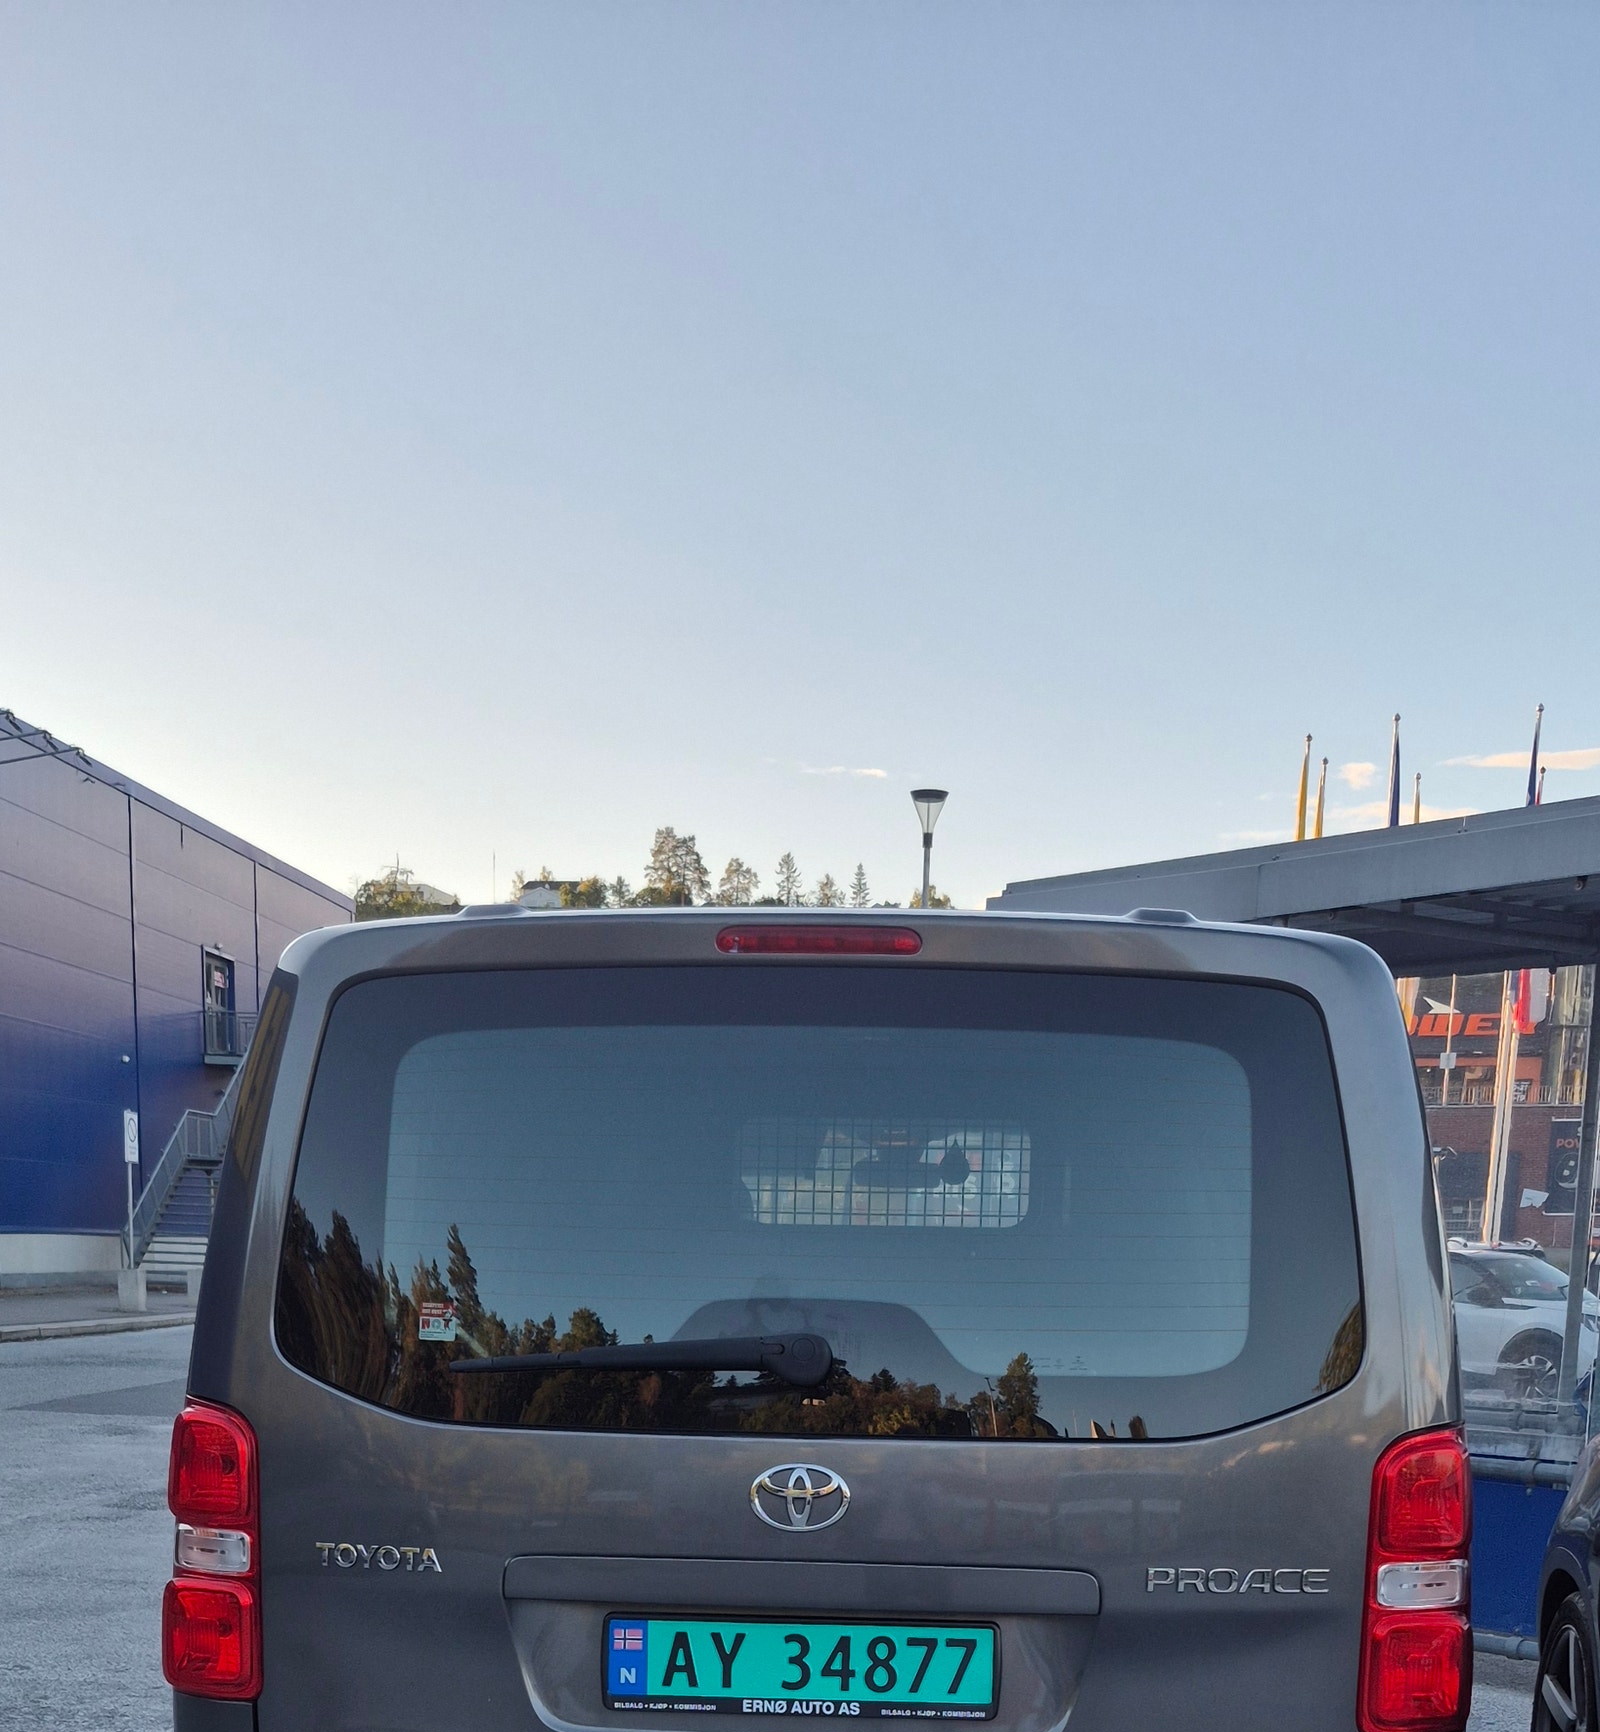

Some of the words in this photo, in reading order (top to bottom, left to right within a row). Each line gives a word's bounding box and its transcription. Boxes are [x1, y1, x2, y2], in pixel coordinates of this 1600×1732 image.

[315, 1541, 443, 1573] TOYOTA
[1146, 1567, 1331, 1594] PROACE
[619, 1667, 637, 1684] N
[661, 1631, 747, 1690] AY
[780, 1633, 979, 1694] 34877
[742, 1699, 787, 1714] ERNØ
[790, 1700, 835, 1715] AUTO
[838, 1702, 861, 1716] AS
